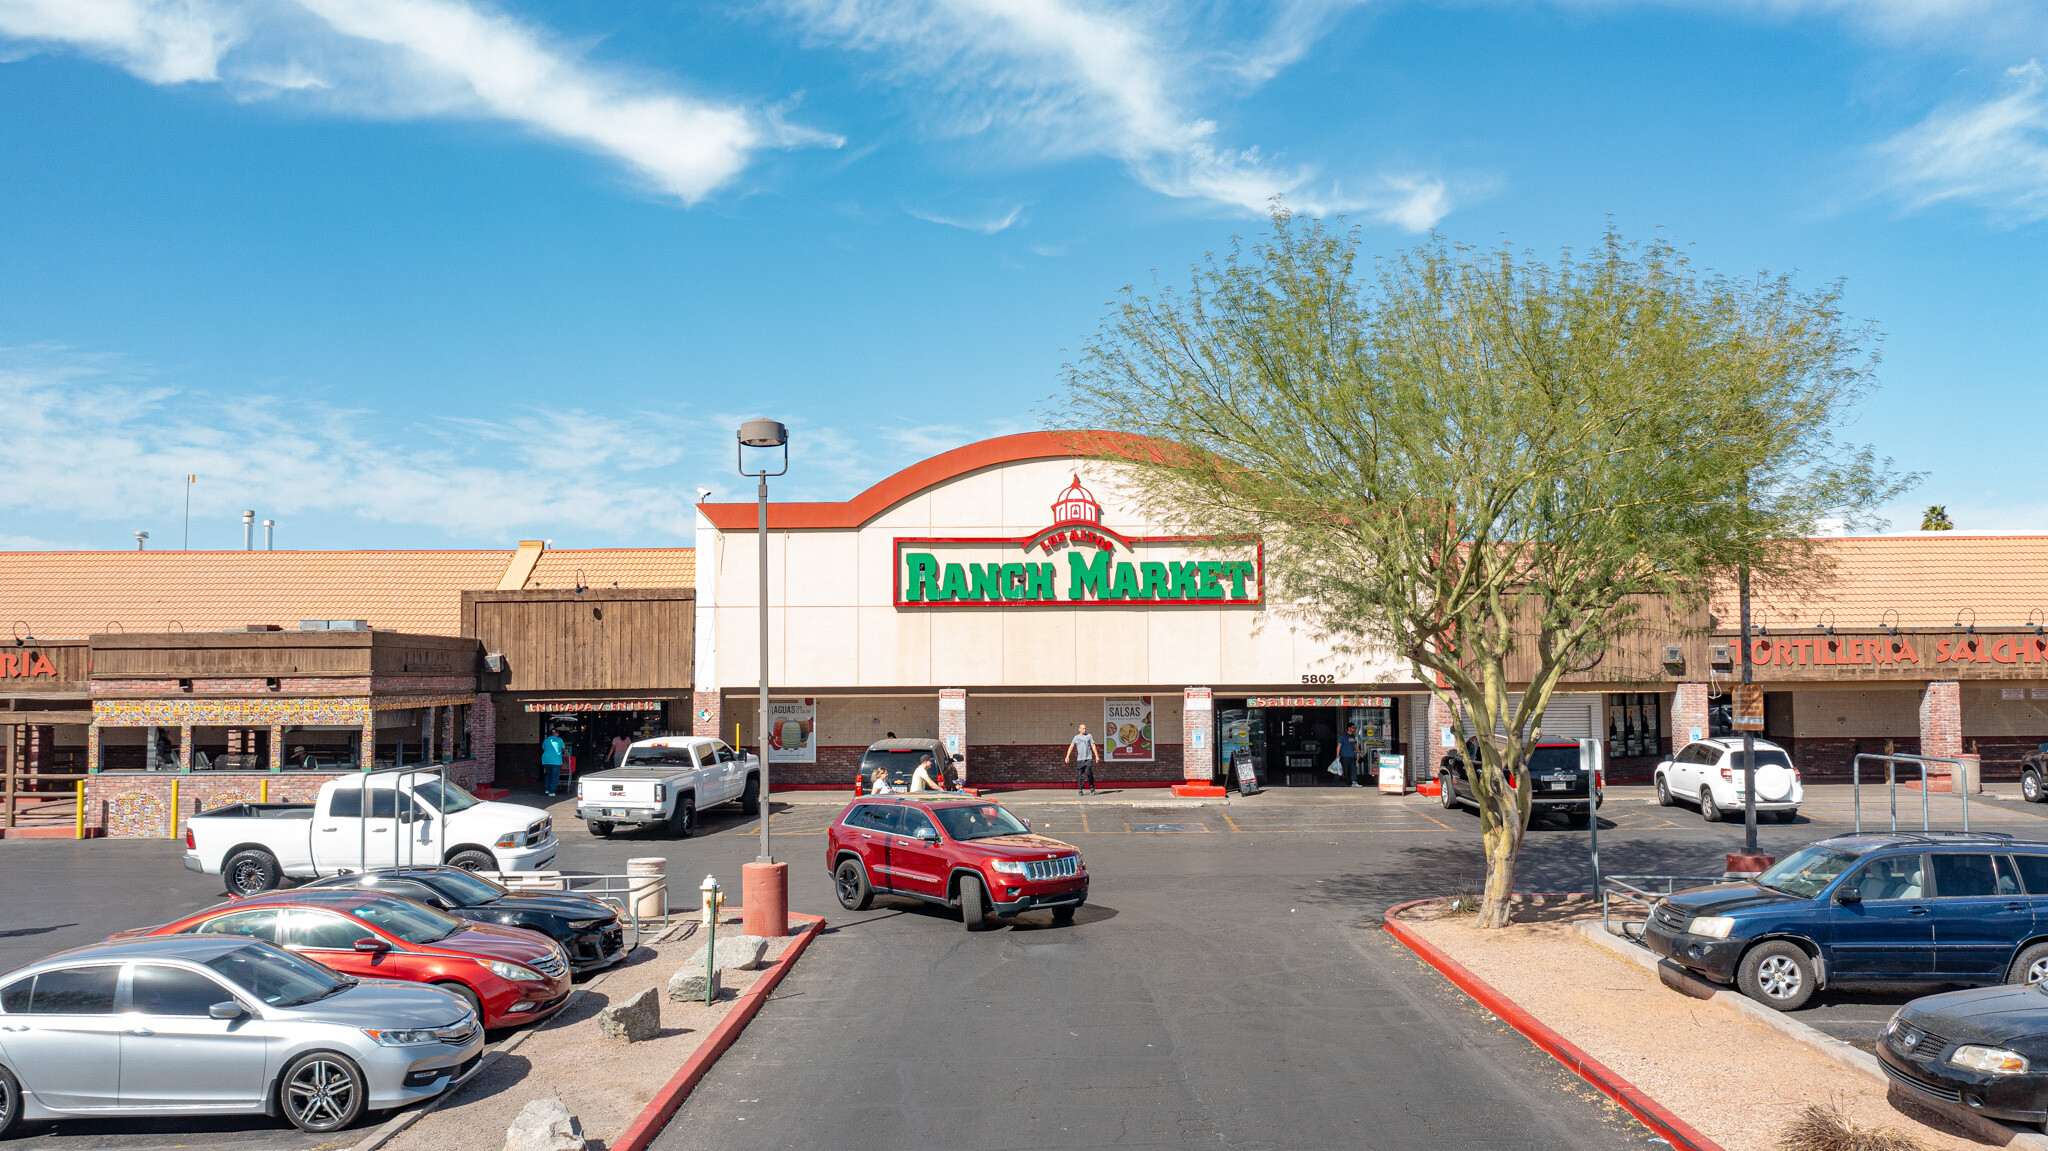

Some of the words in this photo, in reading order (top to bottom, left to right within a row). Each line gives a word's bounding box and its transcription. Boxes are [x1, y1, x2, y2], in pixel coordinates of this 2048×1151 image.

[1039, 531, 1067, 551] LOS
[1069, 529, 1114, 552] ALTOS
[906, 552, 1054, 601] RANCH
[1068, 551, 1252, 599] MARKET
[1729, 638, 1919, 666] TORTILLERIA
[0, 651, 58, 678] RIA
[1301, 674, 1335, 684] 5802
[529, 701, 594, 713] ENTRADA
[610, 700, 654, 711] ENTER
[1109, 706, 1141, 717] SALSAS
